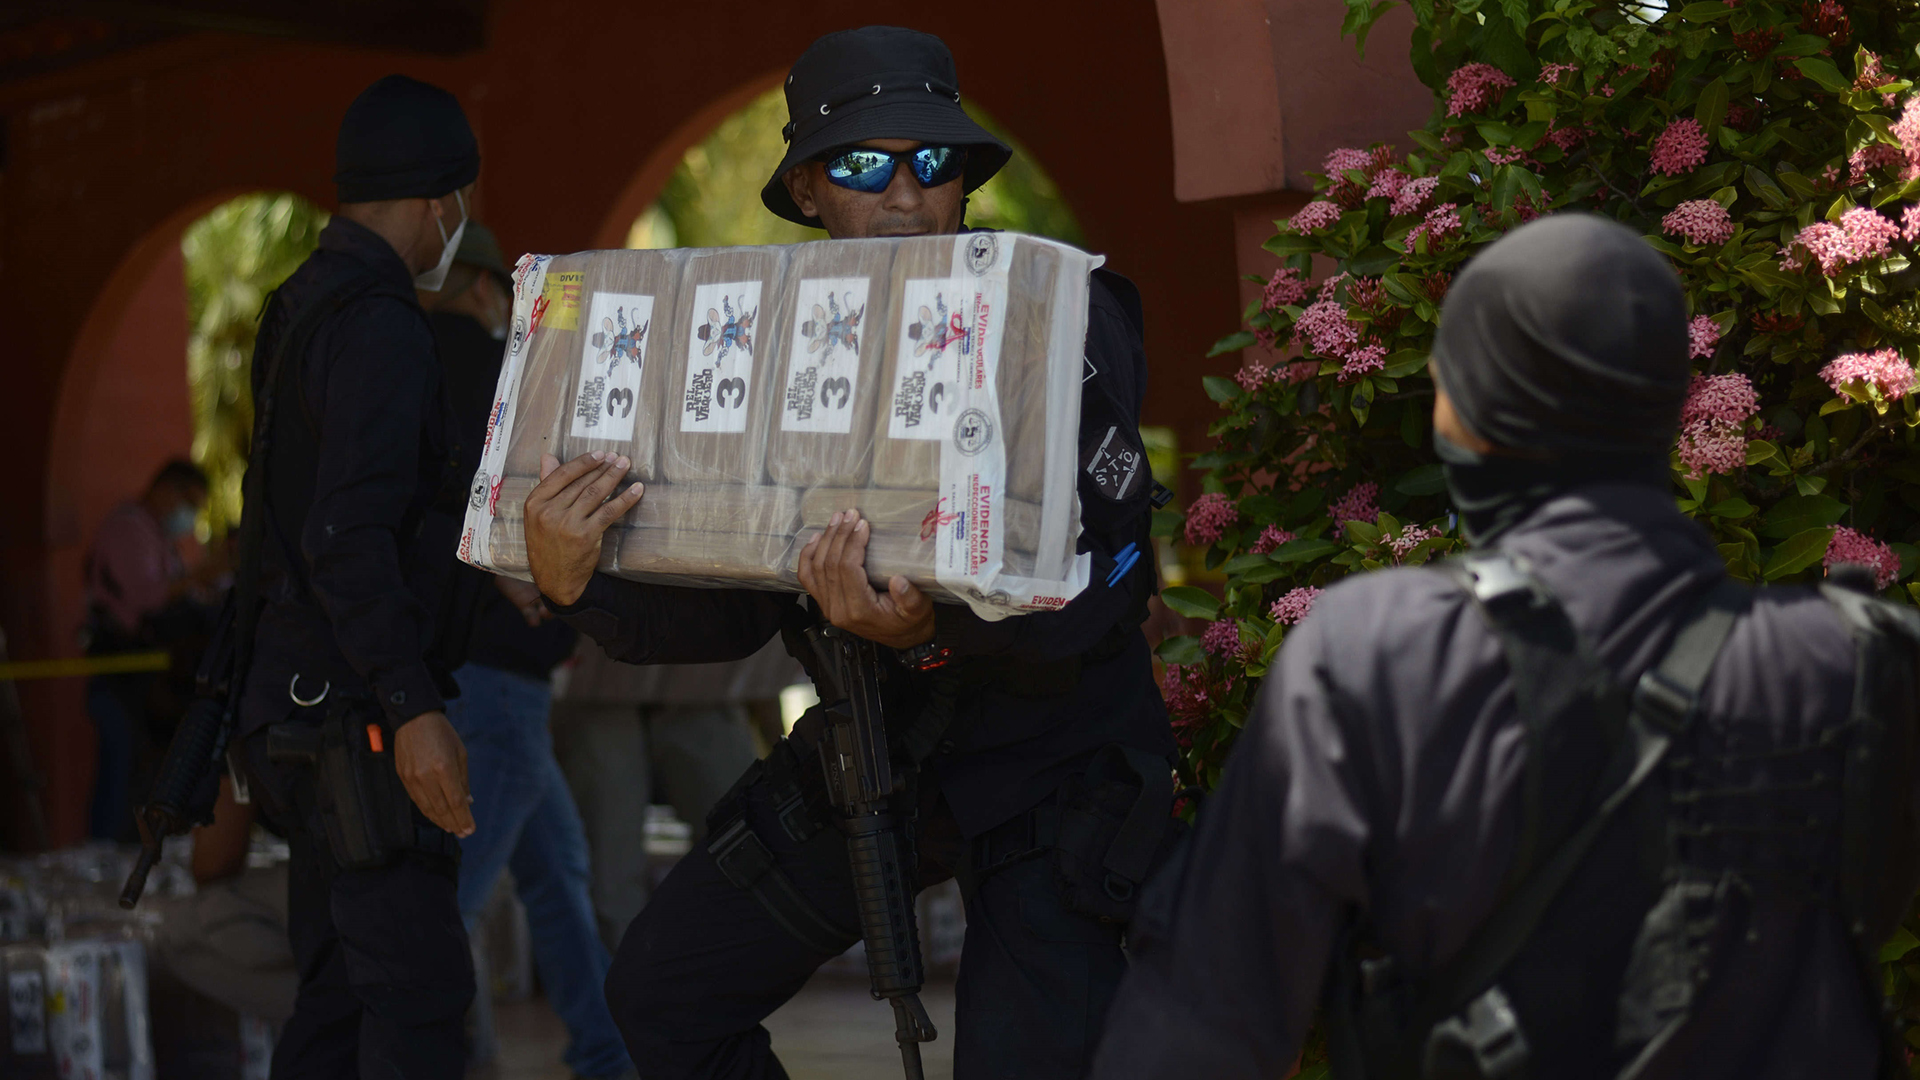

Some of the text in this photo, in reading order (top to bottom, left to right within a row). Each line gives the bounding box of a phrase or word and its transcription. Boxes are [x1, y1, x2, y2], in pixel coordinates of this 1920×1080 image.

[606, 387, 633, 418] 3
[716, 377, 745, 409] 3
[820, 377, 850, 409] 3
[929, 381, 960, 416] 3
[971, 473, 979, 531] INSPECCIONES
[979, 485, 990, 564] EVIDENCIA
